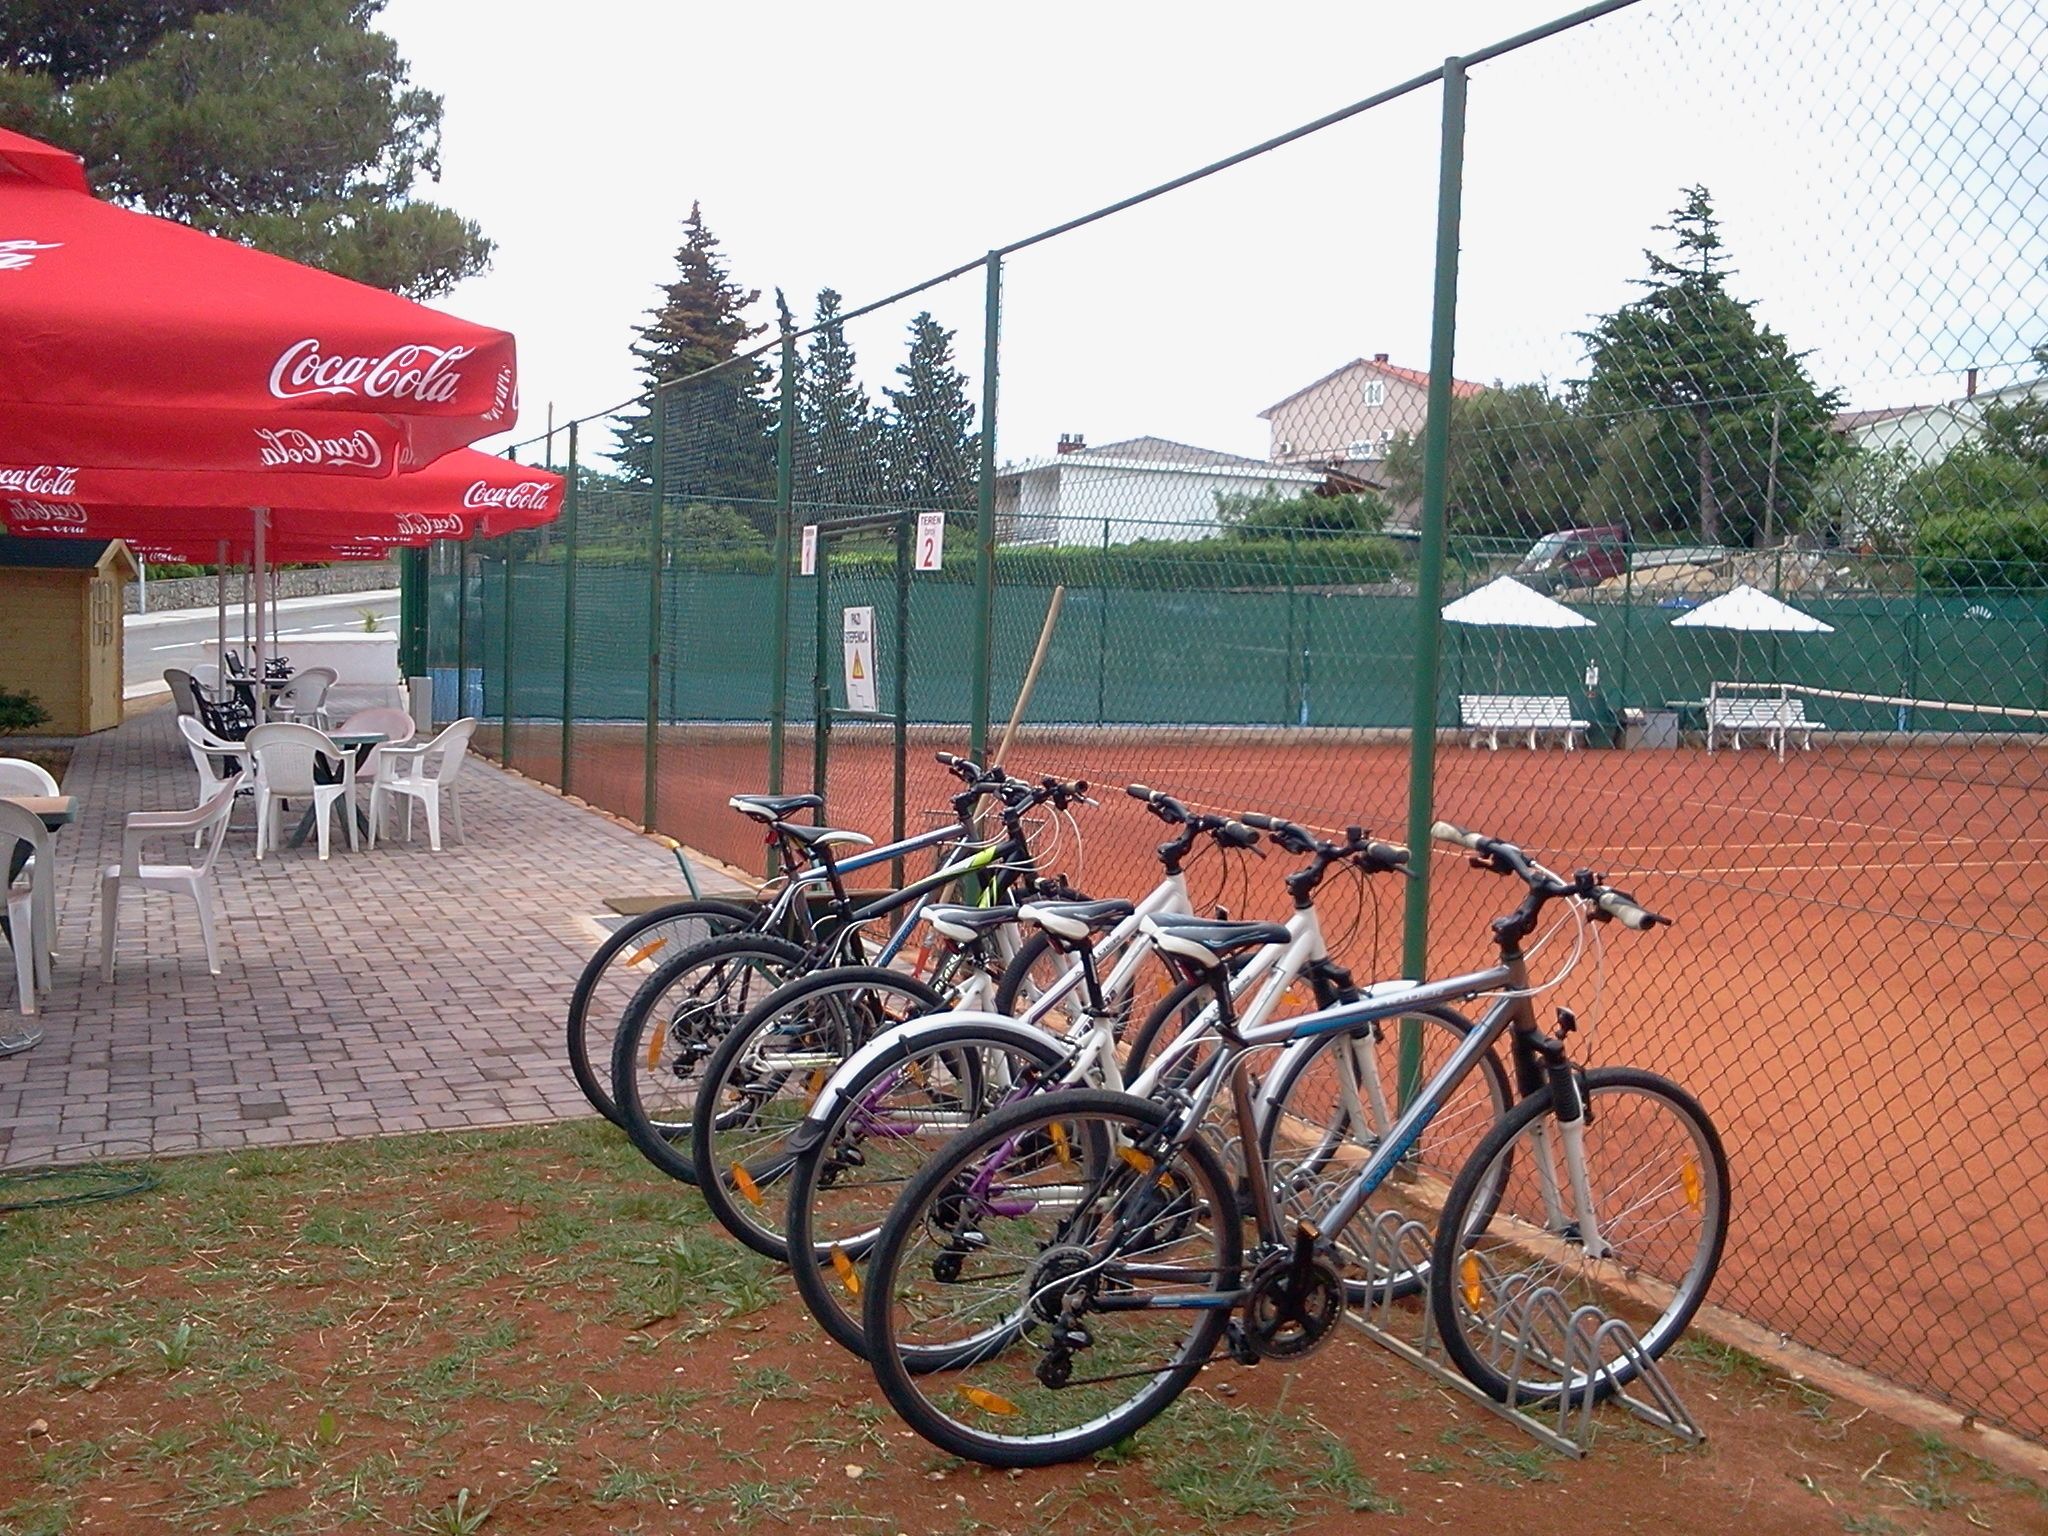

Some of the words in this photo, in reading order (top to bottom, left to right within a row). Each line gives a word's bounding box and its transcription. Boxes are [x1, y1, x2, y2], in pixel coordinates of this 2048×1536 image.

[270, 339, 475, 402] Coca-Cola
[0, 465, 79, 495] ca-Cola
[464, 480, 555, 510] Coca-Cola
[924, 538, 934, 567] 2
